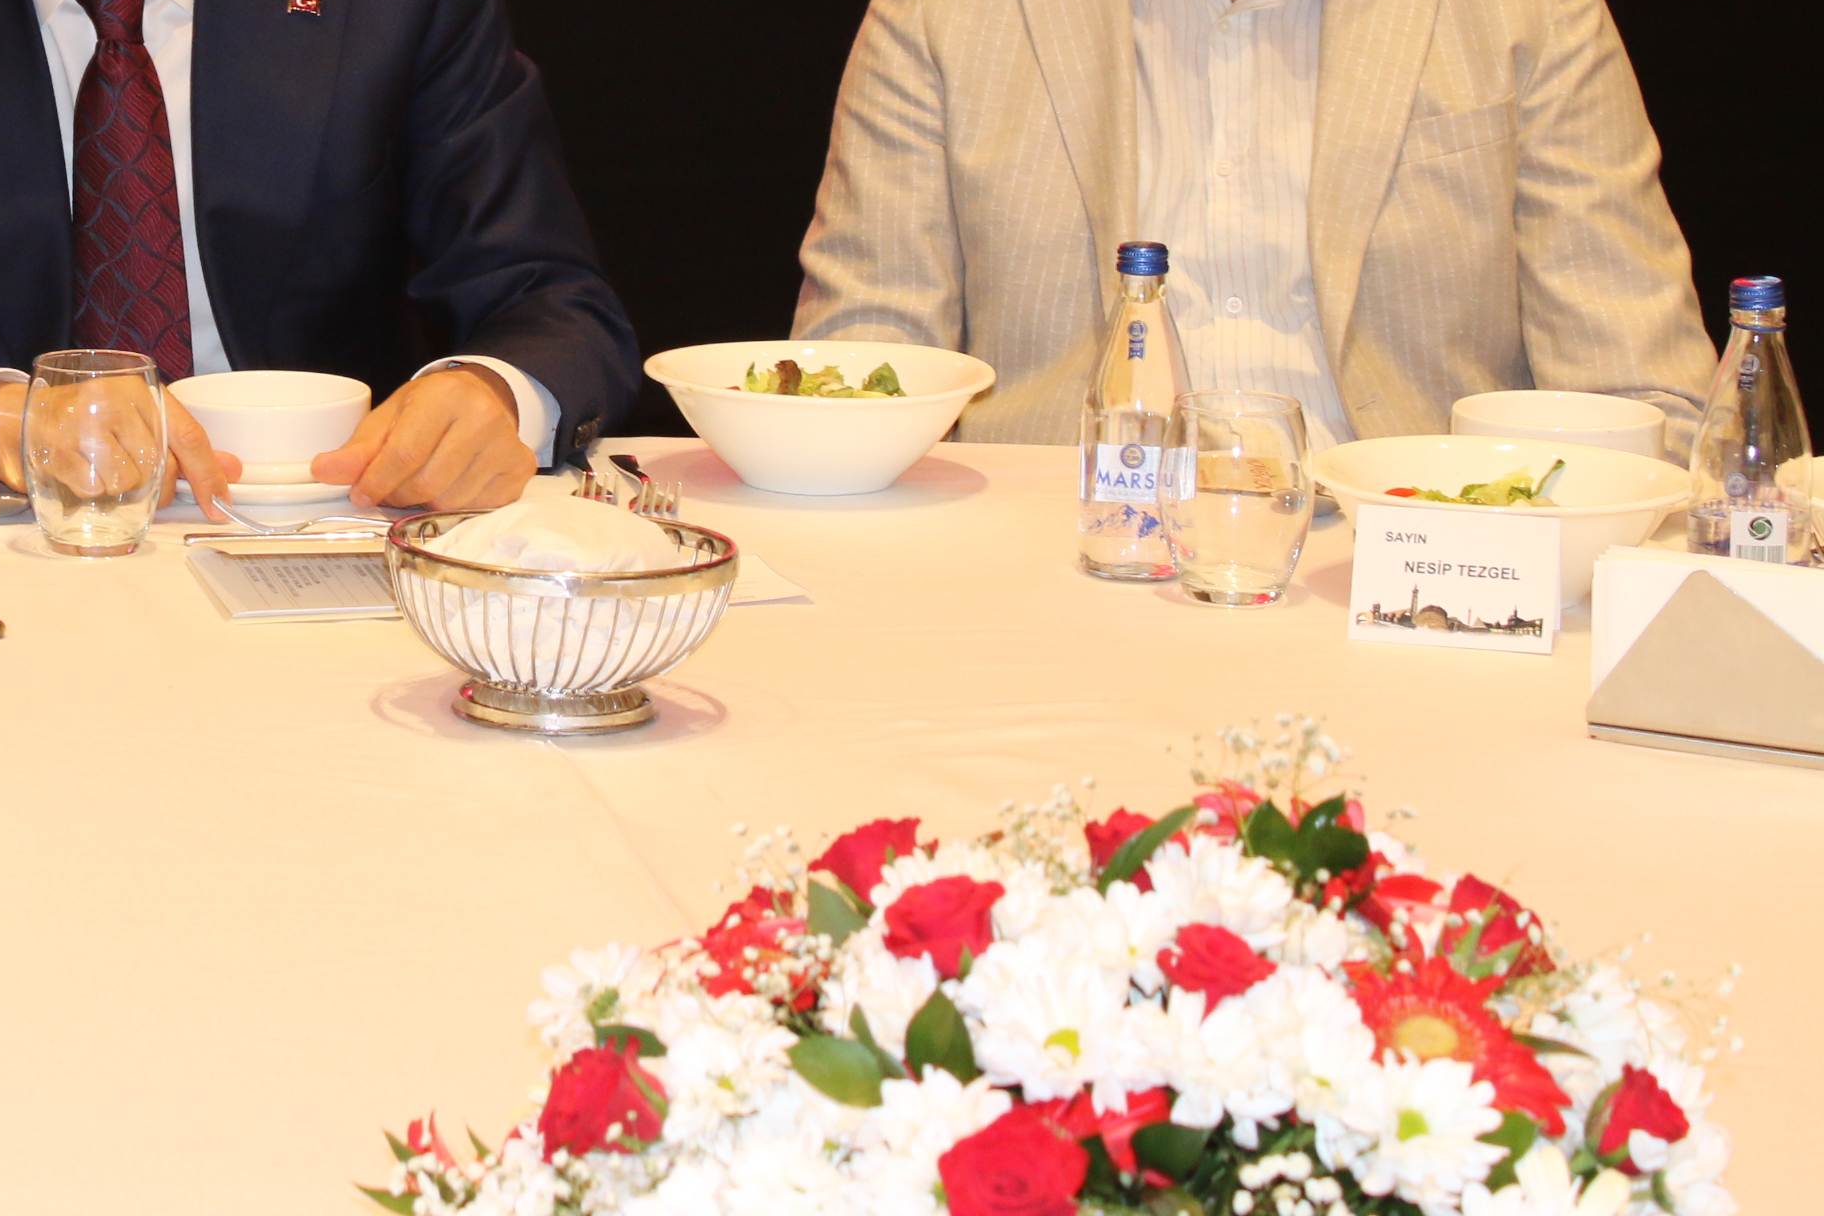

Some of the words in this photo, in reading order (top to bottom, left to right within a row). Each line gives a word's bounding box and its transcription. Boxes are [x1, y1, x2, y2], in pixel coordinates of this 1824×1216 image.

[1384, 531, 1427, 544] SAYIN
[1404, 560, 1452, 575] NESİP
[1457, 564, 1521, 580] TEZGEL
